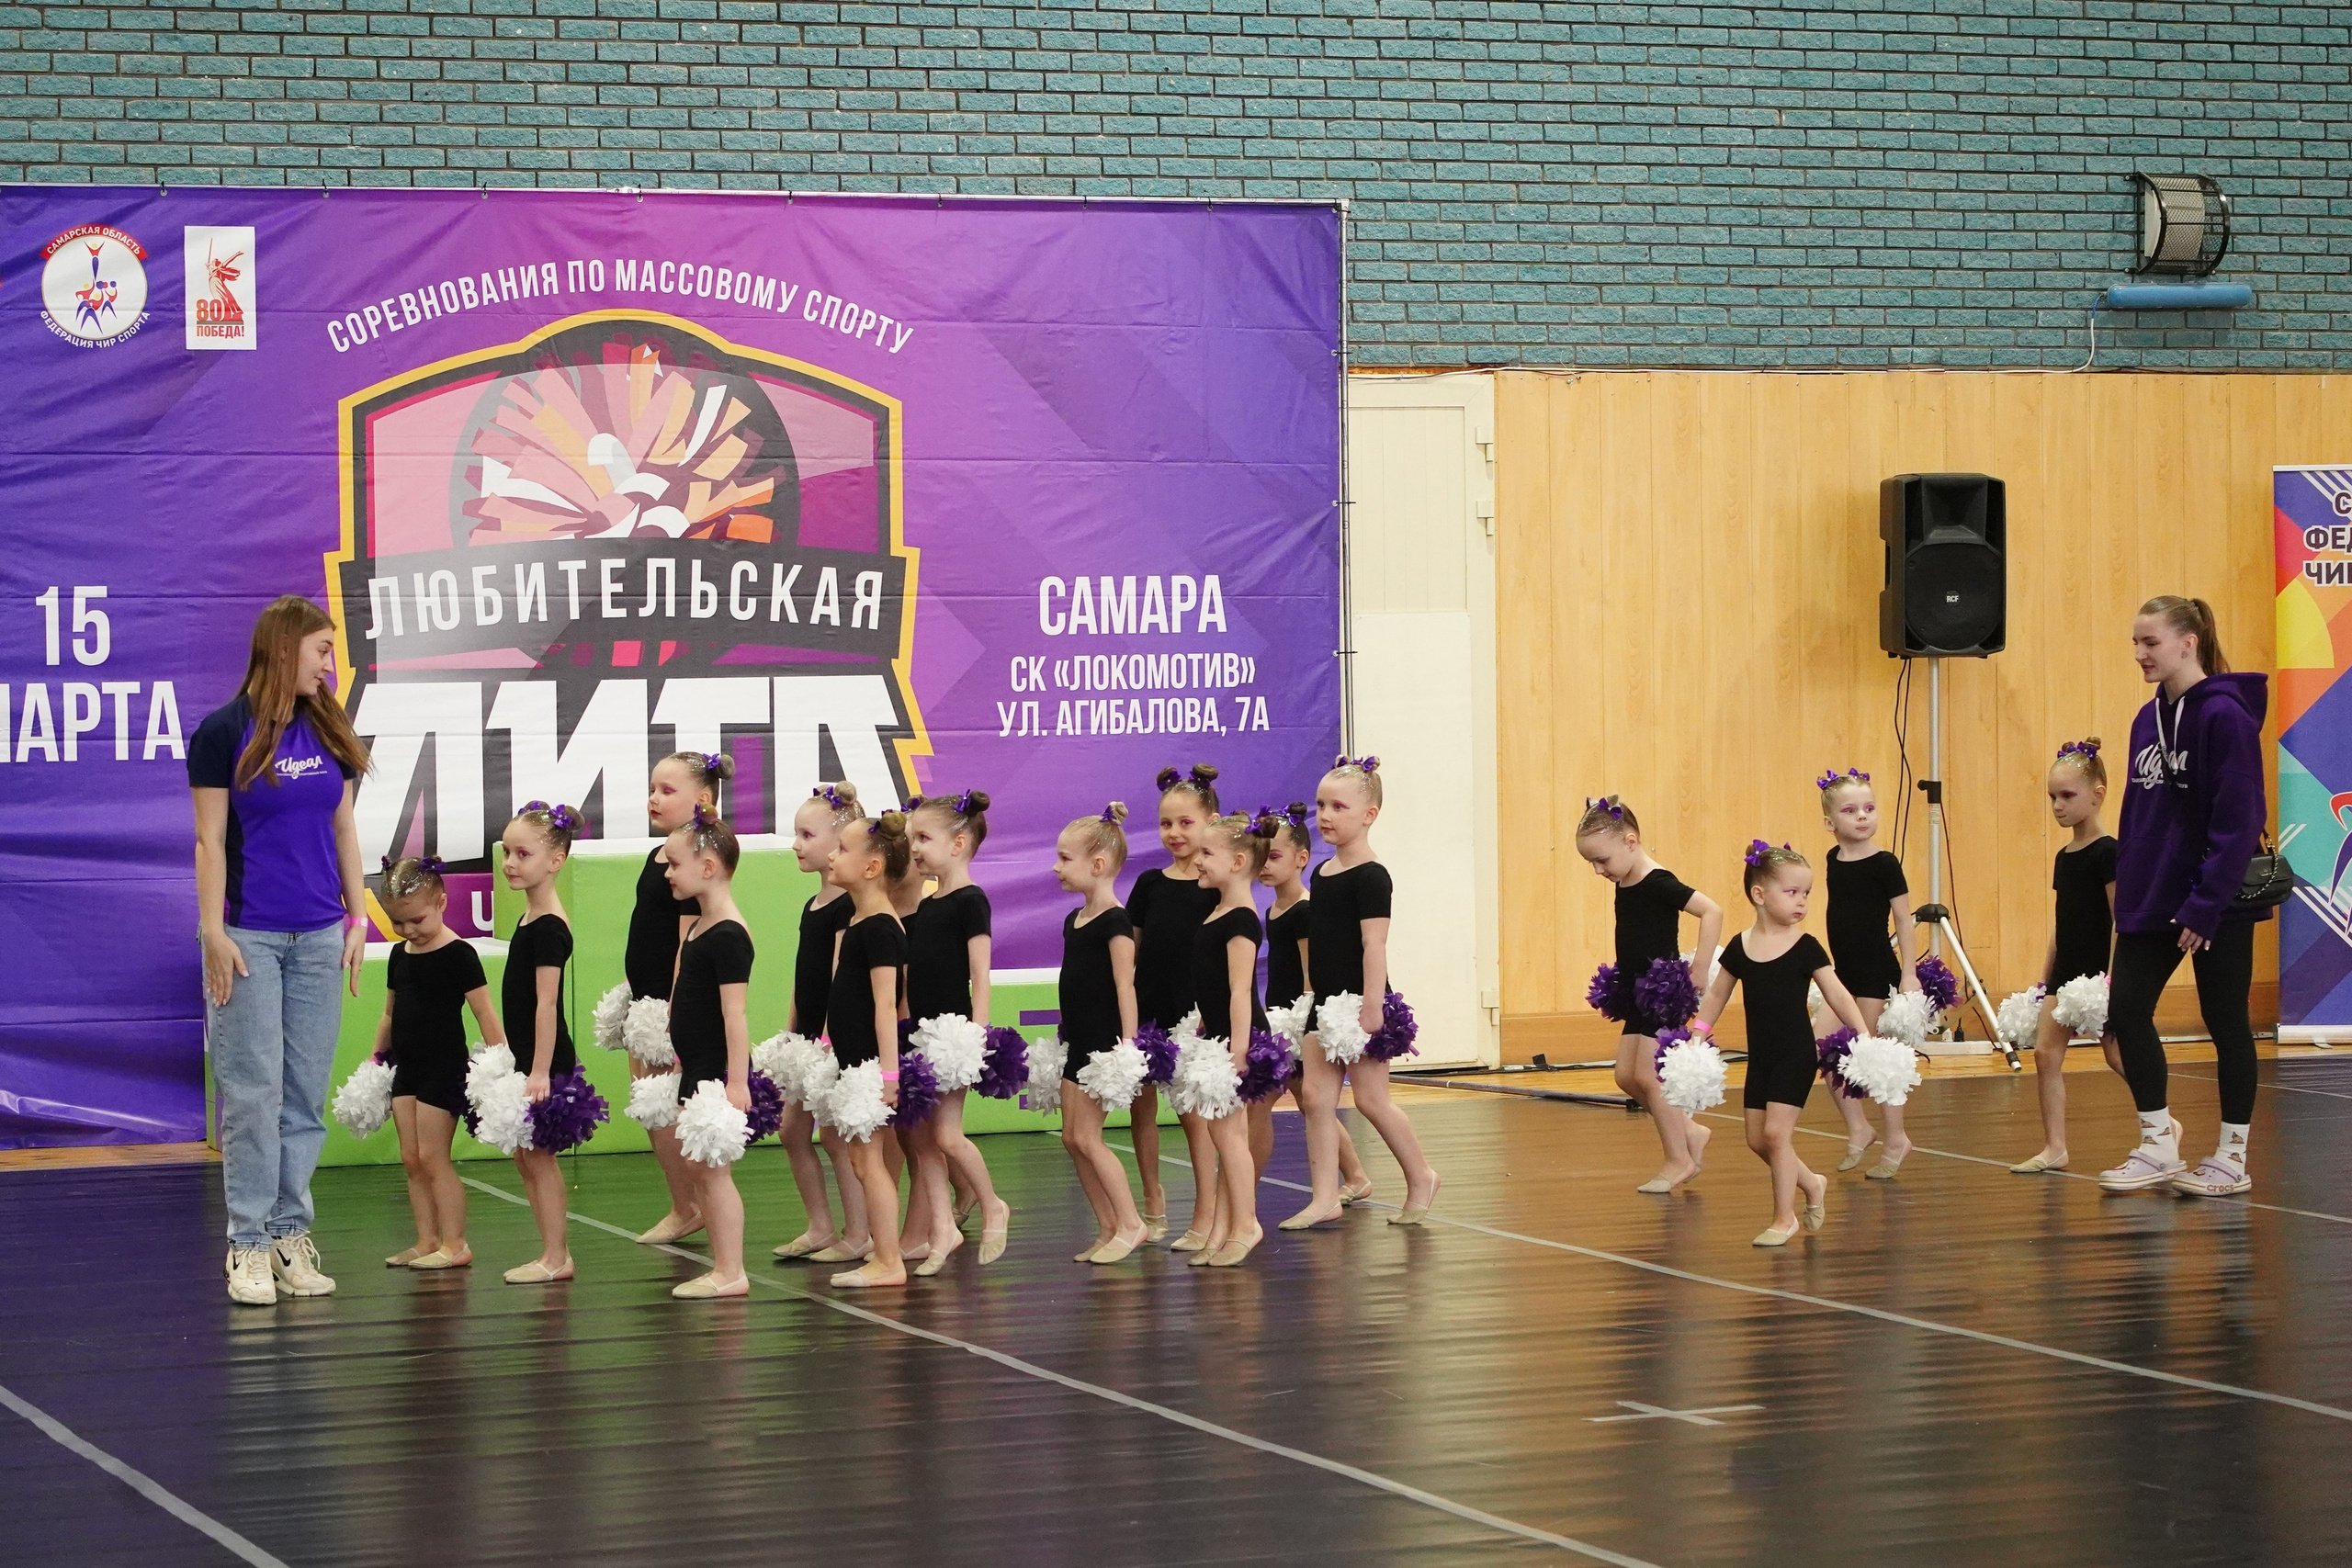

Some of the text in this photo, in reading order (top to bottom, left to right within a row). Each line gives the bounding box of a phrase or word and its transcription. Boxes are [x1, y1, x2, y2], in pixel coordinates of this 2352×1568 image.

[46, 226, 141, 255] САМАРСКАЯ ОБЛАСТЬ
[196, 299, 222, 321] 80
[326, 259, 915, 355] СОРЕВНОВАНИЯ ПО МАССОВОМУ СПОРТУ
[40, 310, 151, 349] ФЕДЕРАЦИЯ ЧИР СПОРТА
[196, 324, 245, 339] ПОБЕДА!
[2303, 525, 2352, 555] ФЕ
[2303, 560, 2352, 586] ЧИ
[365, 557, 885, 641] ЛЮБИТЕЛЬСКАЯ
[1038, 574, 1227, 637] САМАРА
[35, 585, 111, 667] 15
[1010, 652, 1256, 693] СК «ЛОКОМОТИВ»
[0, 680, 187, 764] АРТА
[996, 695, 1271, 738] УЛ. АГИБАЛОВА, 7А
